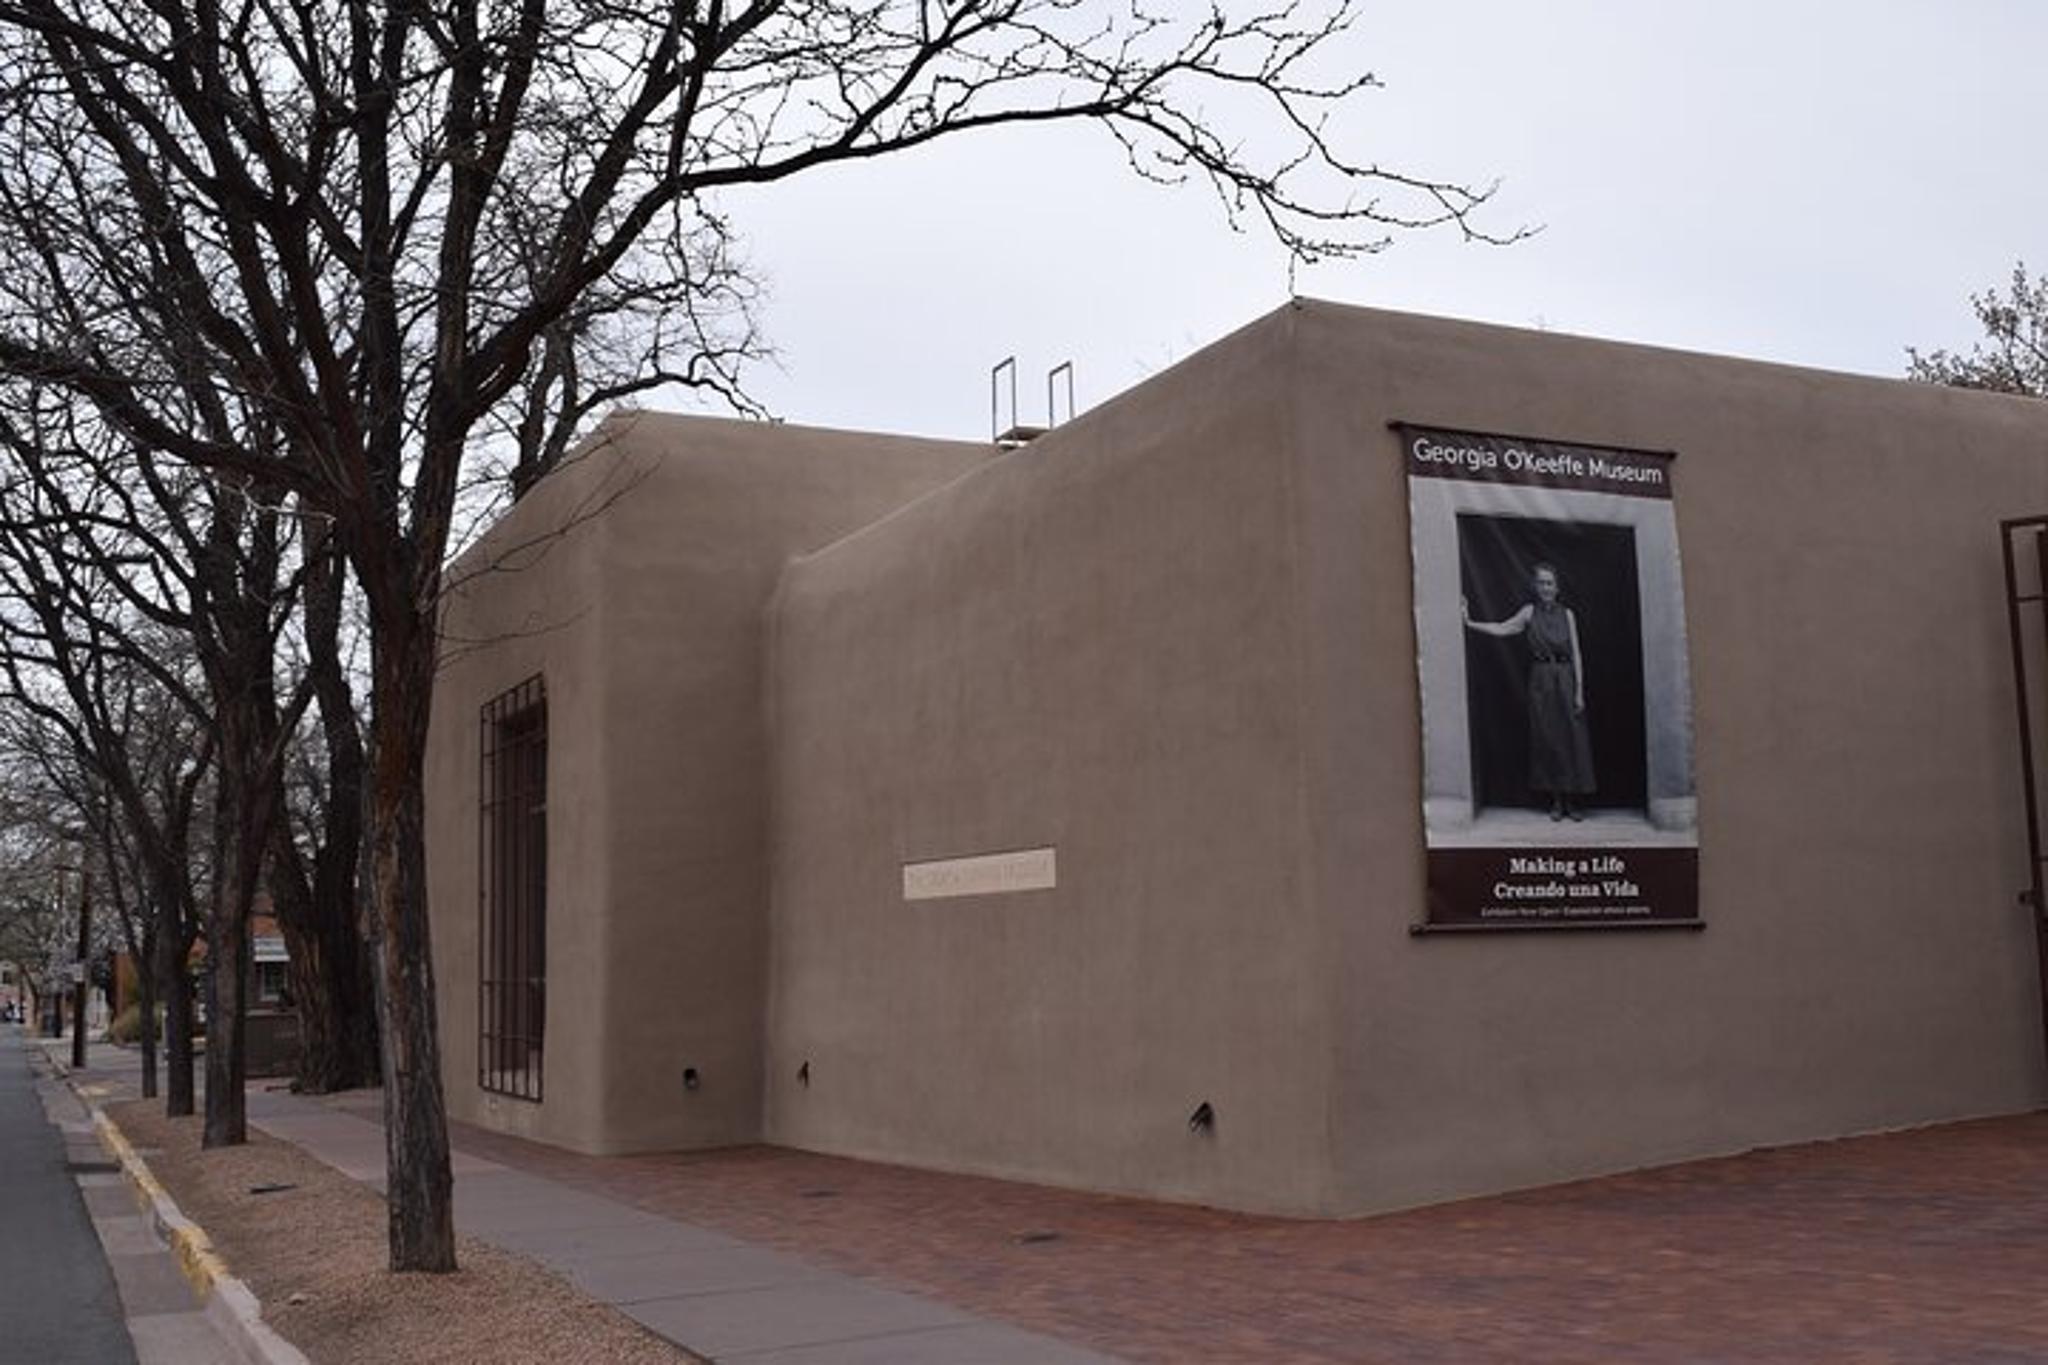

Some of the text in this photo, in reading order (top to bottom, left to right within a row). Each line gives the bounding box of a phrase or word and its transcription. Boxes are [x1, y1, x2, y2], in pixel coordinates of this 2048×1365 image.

[1412, 438, 1498, 471] Georgia
[1589, 457, 1663, 483] Museum
[1510, 857, 1625, 877] Making a Life
[1494, 880, 1640, 899] Creando una Vida
